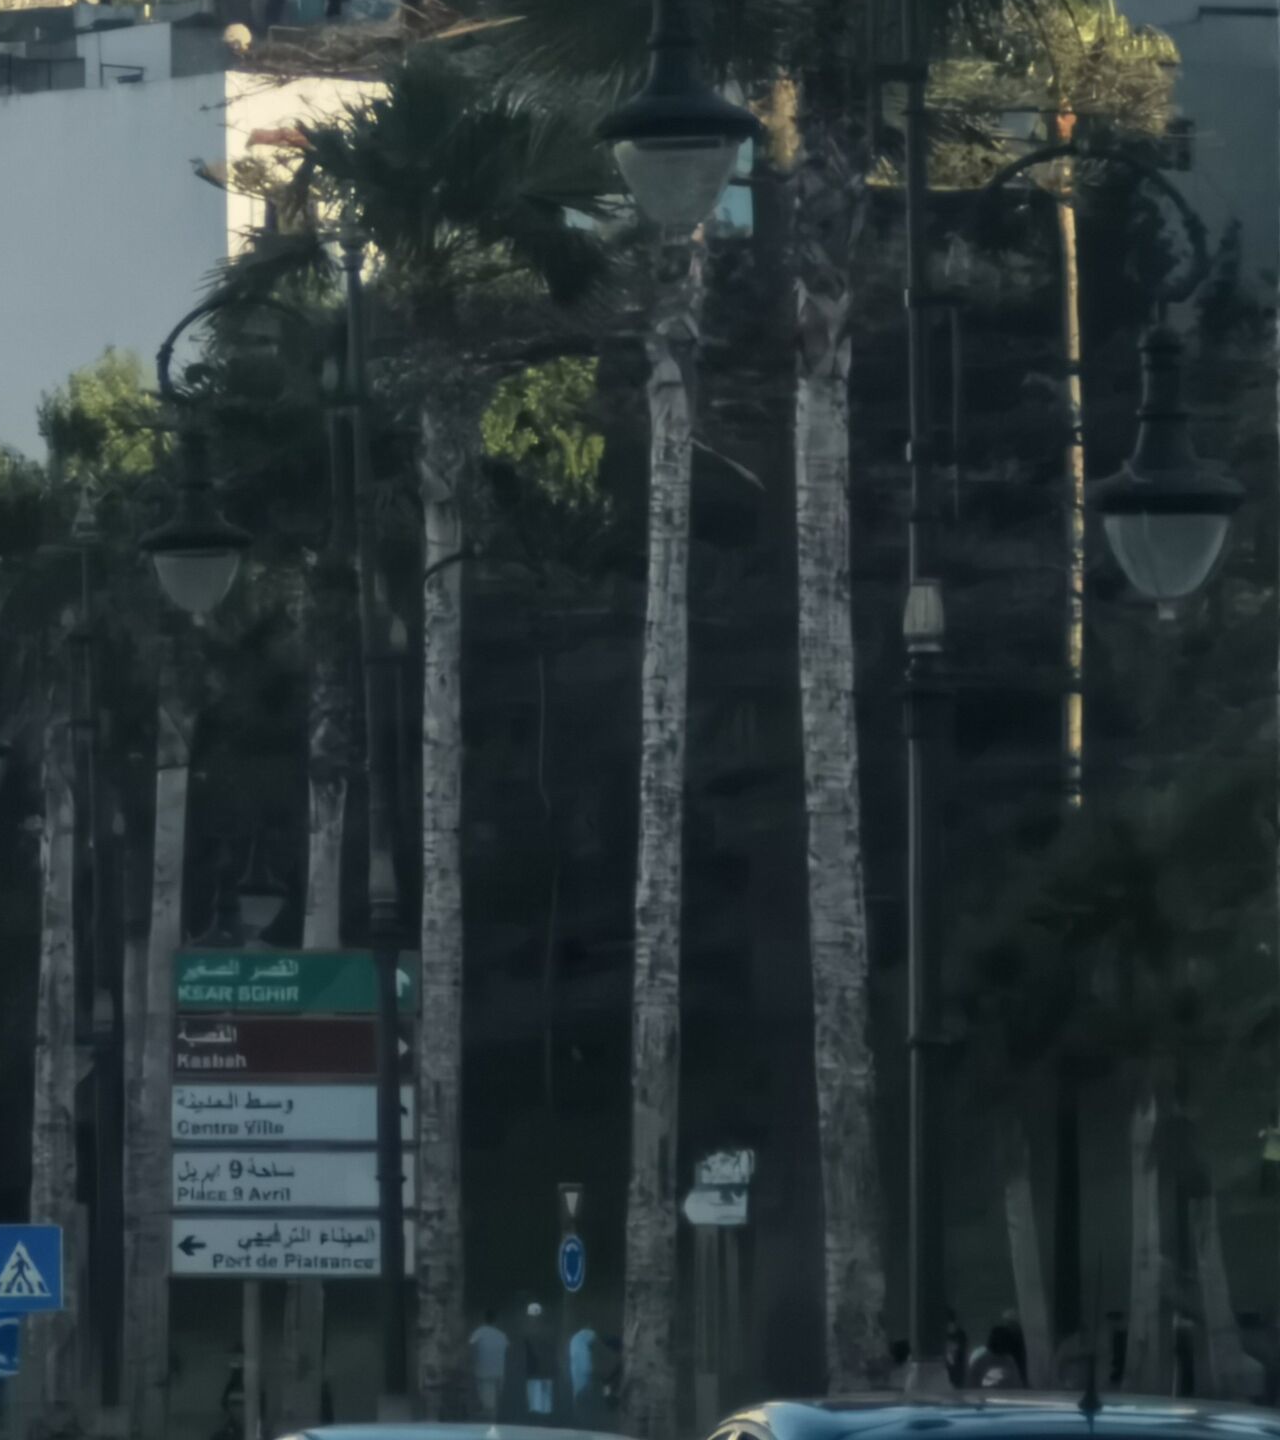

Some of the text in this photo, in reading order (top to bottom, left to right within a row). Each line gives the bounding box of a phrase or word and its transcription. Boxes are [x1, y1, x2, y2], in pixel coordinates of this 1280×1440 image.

[177, 985, 299, 1002] KSAR SGHIR
[177, 1022, 237, 1047] القصبة
[177, 1053, 247, 1069] Kasbah
[177, 1089, 293, 1114] وسط المدينة
[177, 1119, 284, 1135] Centre Ville
[229, 1160, 243, 1179] 9
[248, 1157, 295, 1177] ساحة
[177, 1186, 291, 1202] Place 9 Avril
[320, 1226, 375, 1247] الميناء
[212, 1253, 374, 1270] Port de Plaisance
